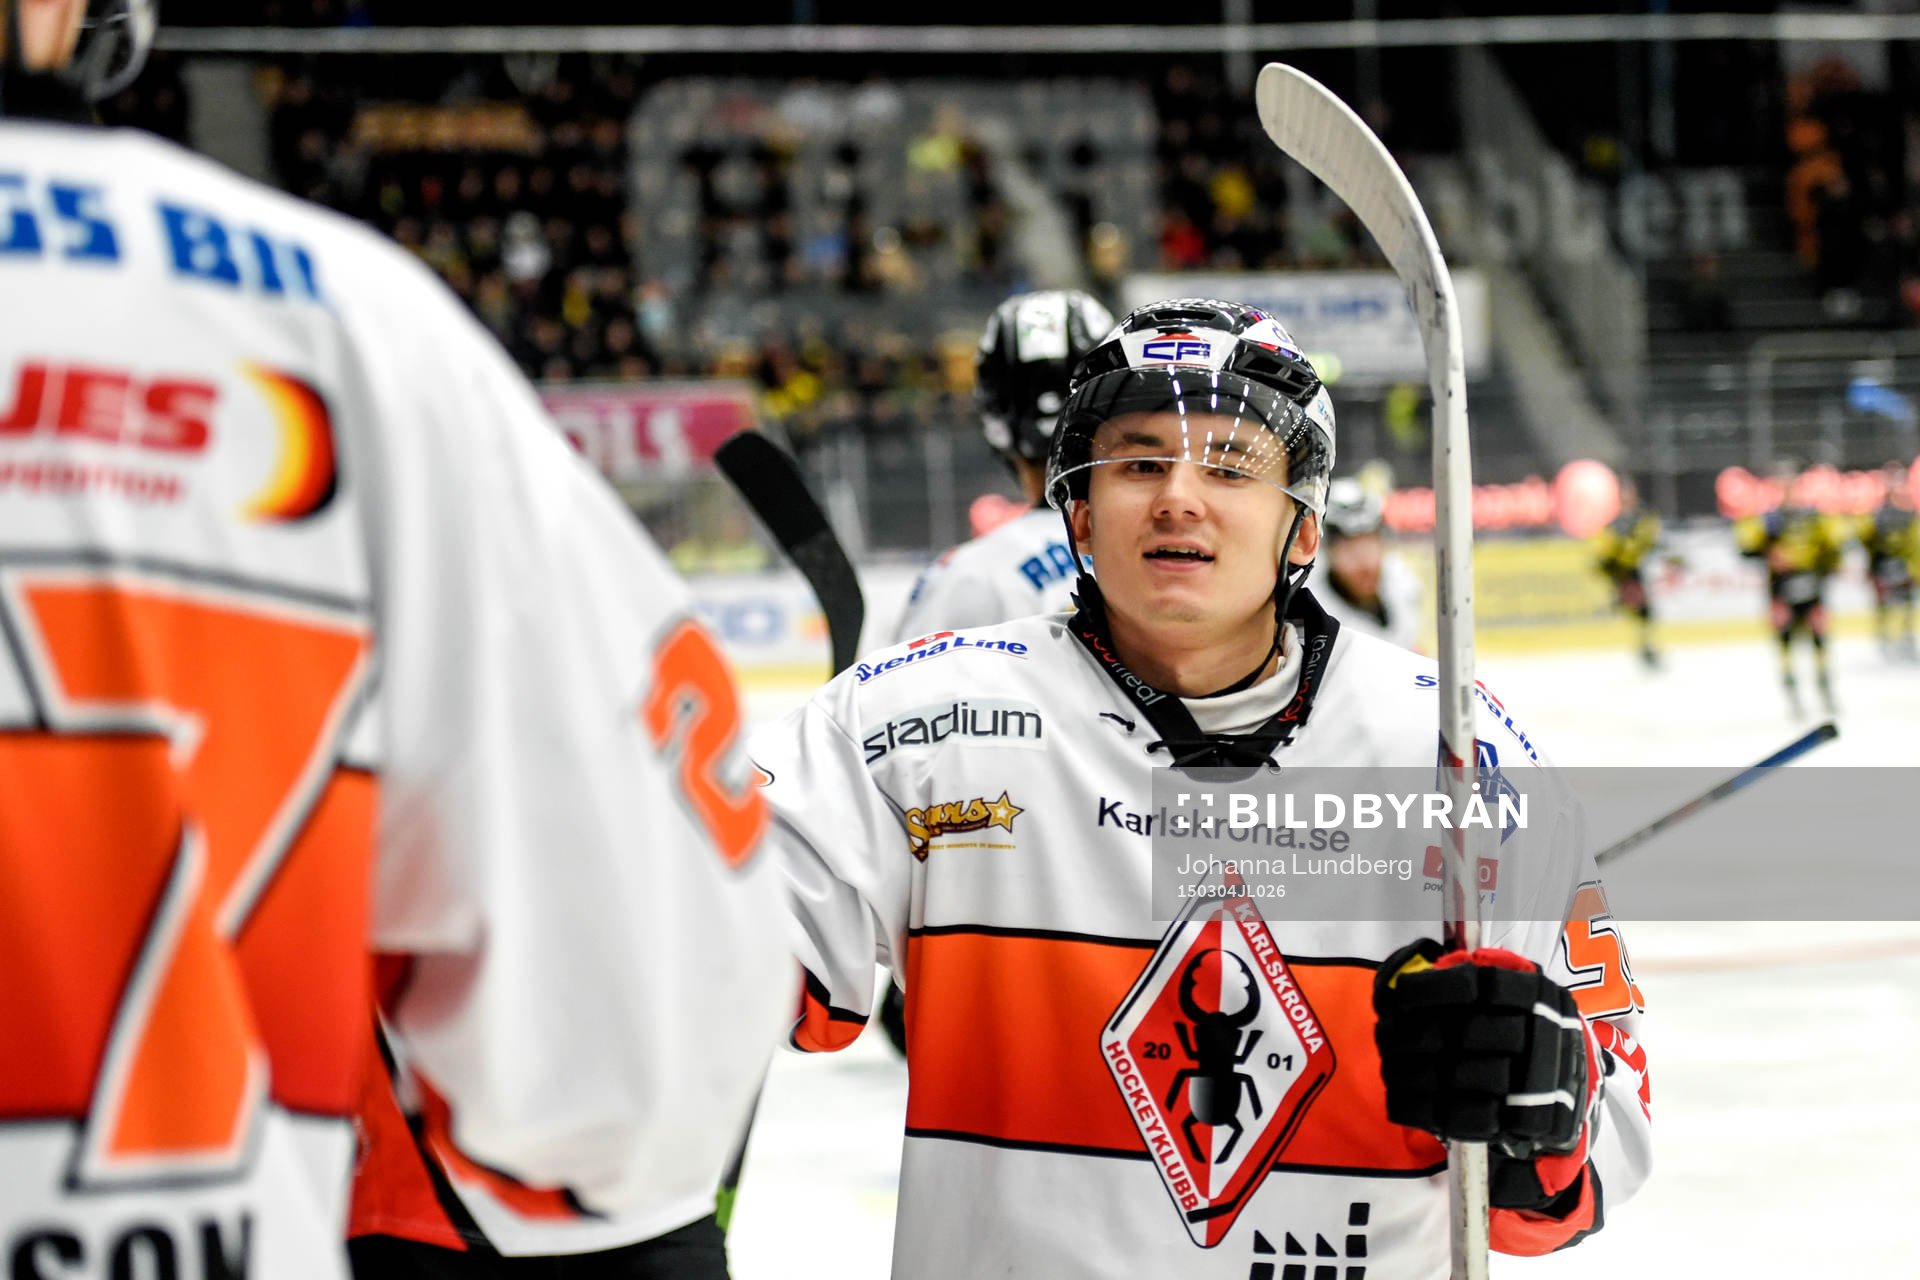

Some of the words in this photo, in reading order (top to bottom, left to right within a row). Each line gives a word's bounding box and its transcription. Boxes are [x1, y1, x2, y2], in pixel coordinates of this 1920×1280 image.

[855, 641, 948, 682] Stena
[953, 637, 1028, 655] Line
[642, 617, 772, 872] 2
[863, 701, 1042, 765] stadium
[1504, 716, 1538, 761] Lin
[1098, 797, 1350, 853] Karlskrona.se
[0, 553, 376, 1192] 7
[1234, 902, 1325, 1056] KARLSKRONA
[1142, 1041, 1172, 1060] 20
[1266, 1052, 1294, 1072] 01
[1105, 1040, 1200, 1213] HOCKEYKLUBB
